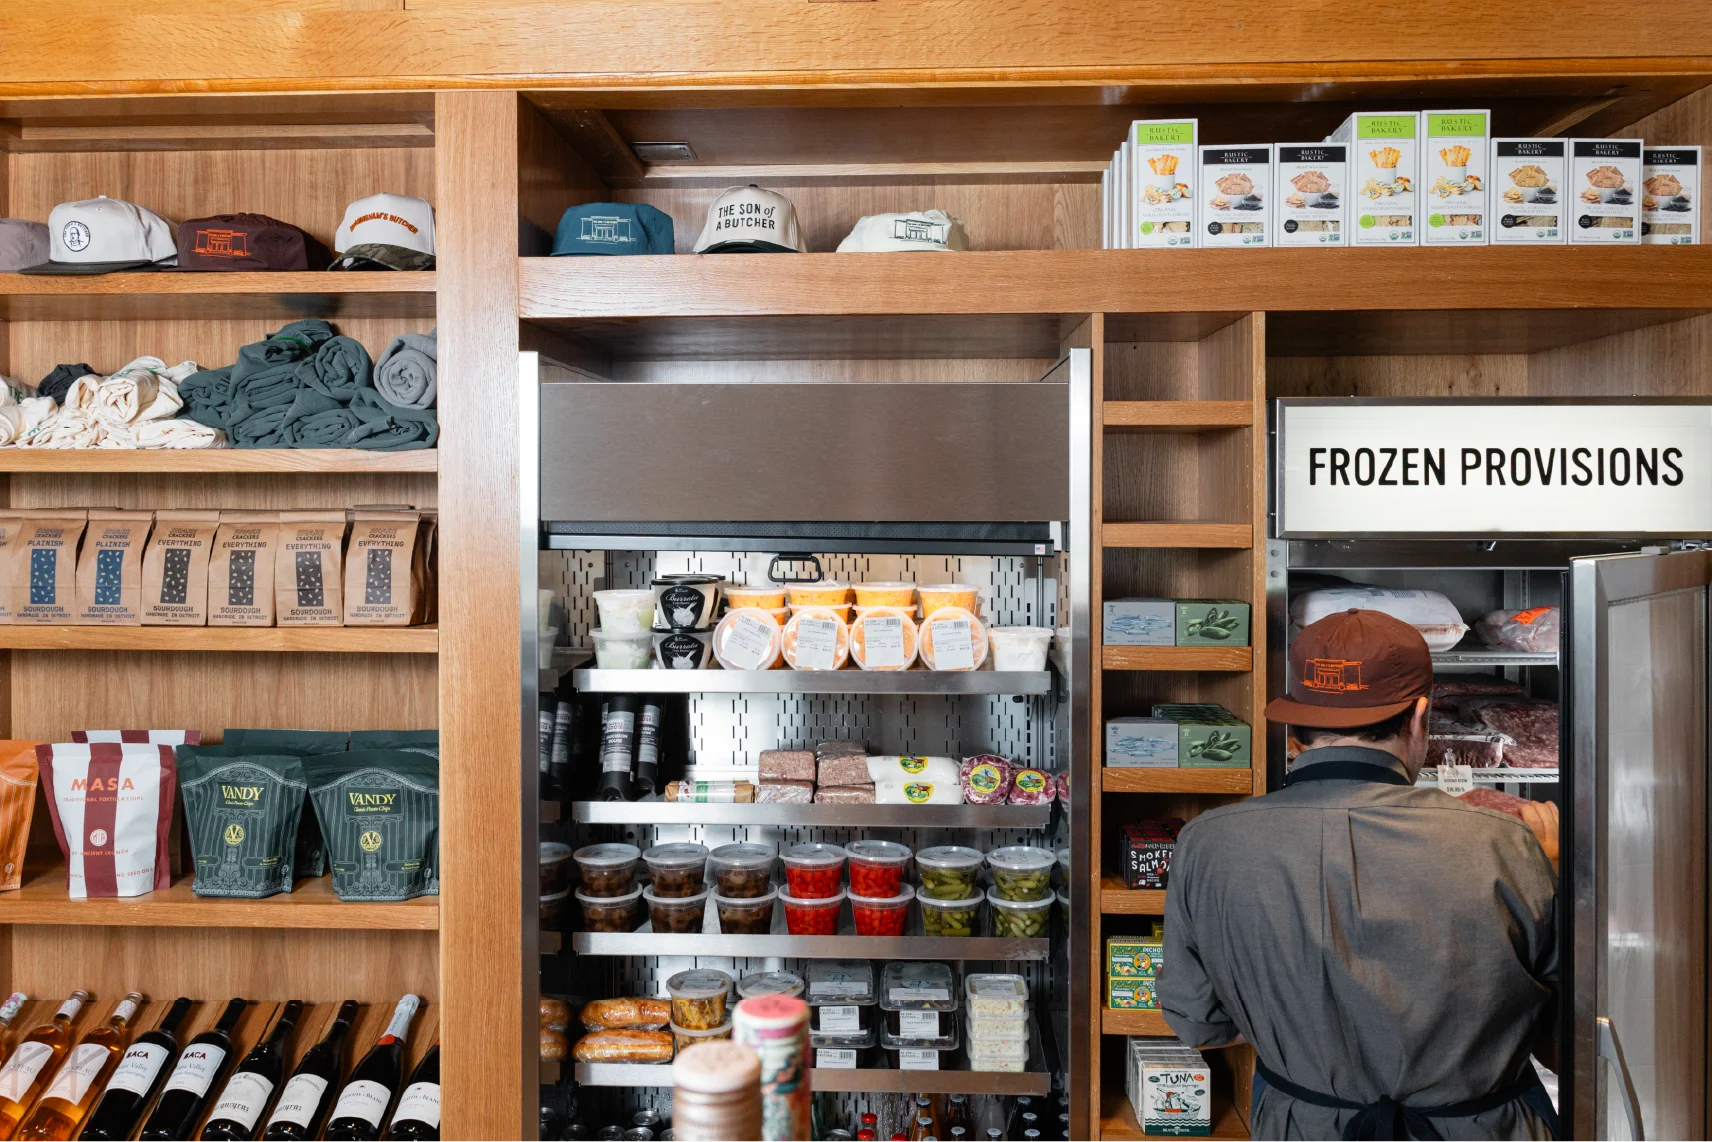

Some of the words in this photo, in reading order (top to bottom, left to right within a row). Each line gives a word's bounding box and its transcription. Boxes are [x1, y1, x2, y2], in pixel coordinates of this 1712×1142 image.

[718, 204, 735, 218] THE
[739, 203, 760, 215] SON
[763, 206, 776, 218] of
[389, 214, 419, 235] BUTCHER
[715, 221, 721, 231] A
[724, 217, 775, 230] BUTCHER
[1309, 447, 1446, 486] FROZEN
[1461, 447, 1684, 487] PROVISIONS
[666, 593, 699, 601] Burrata
[71, 777, 135, 791] MASA
[221, 785, 264, 800] VANDY
[348, 792, 397, 805] VANDY
[126, 1051, 149, 1059] BACA
[183, 1051, 206, 1060] BACA
[131, 1061, 148, 1072] Valley
[189, 1061, 206, 1072] Valley
[1160, 1073, 1194, 1084] TUNA
